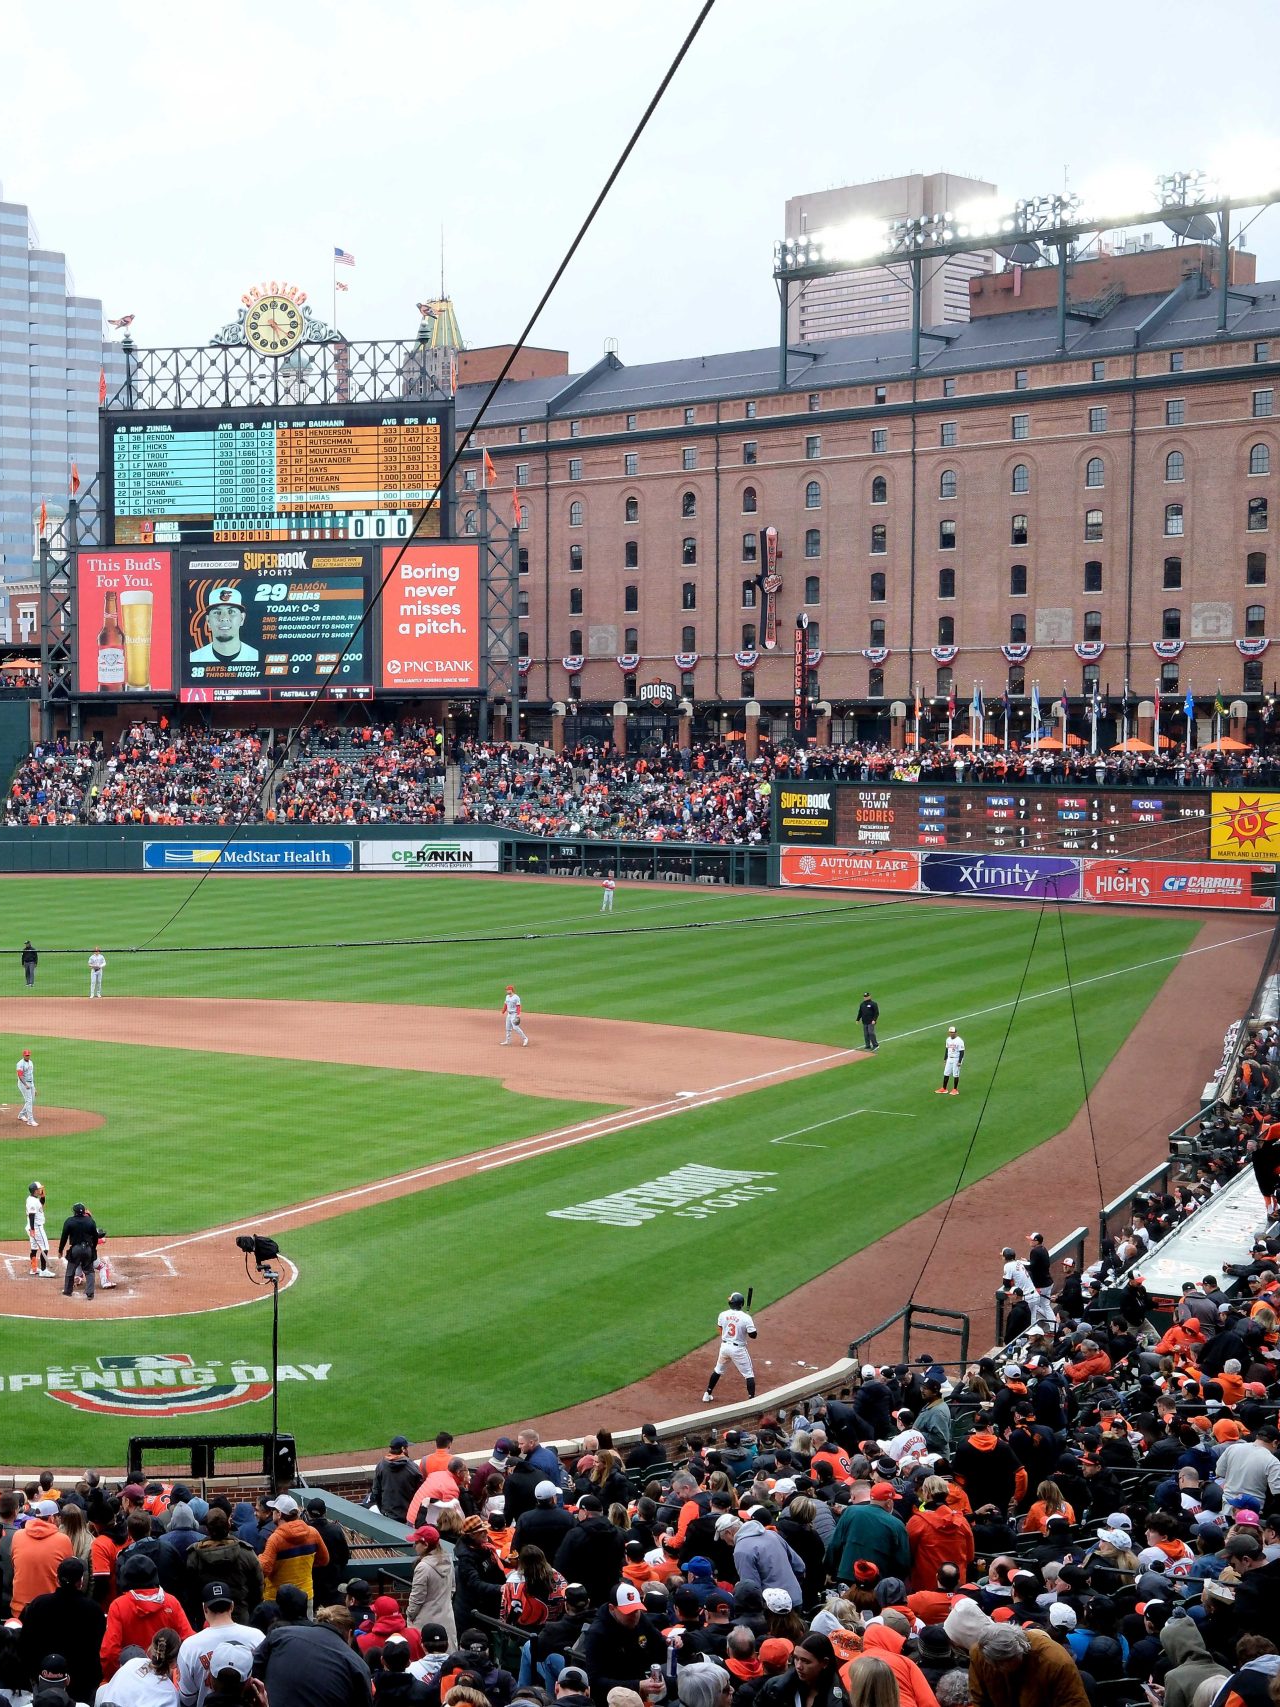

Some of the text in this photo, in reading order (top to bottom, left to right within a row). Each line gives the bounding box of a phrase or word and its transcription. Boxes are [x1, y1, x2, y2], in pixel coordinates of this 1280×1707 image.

[355, 518, 406, 537] 0 0 0
[87, 558, 161, 572] This Bud's
[244, 551, 307, 570] SUPERBOOK
[401, 563, 459, 581] Boring
[96, 574, 153, 588] For You.
[254, 581, 327, 601] 29 RAMÓN
[404, 586, 456, 597] never
[400, 600, 460, 615] misses
[399, 619, 466, 637] a pitch.
[191, 667, 204, 677] 3B
[404, 660, 474, 672] PNC BANK
[641, 685, 672, 700] BOOG'S
[781, 792, 831, 810] SUPERBOOK
[862, 801, 888, 809] TOWN
[856, 810, 894, 822] SCORES
[858, 830, 890, 841] SUPERBOOK
[224, 850, 330, 863] MedStar Health
[820, 858, 908, 870] AUTUMN LAKE
[960, 860, 1039, 891] xfinity
[1096, 876, 1150, 896] HIGH'S
[546, 1163, 778, 1227] SUPERBOOK
[674, 1184, 778, 1219] SPORTS
[728, 1323, 736, 1337] 3
[232, 1363, 332, 1384] DAY
